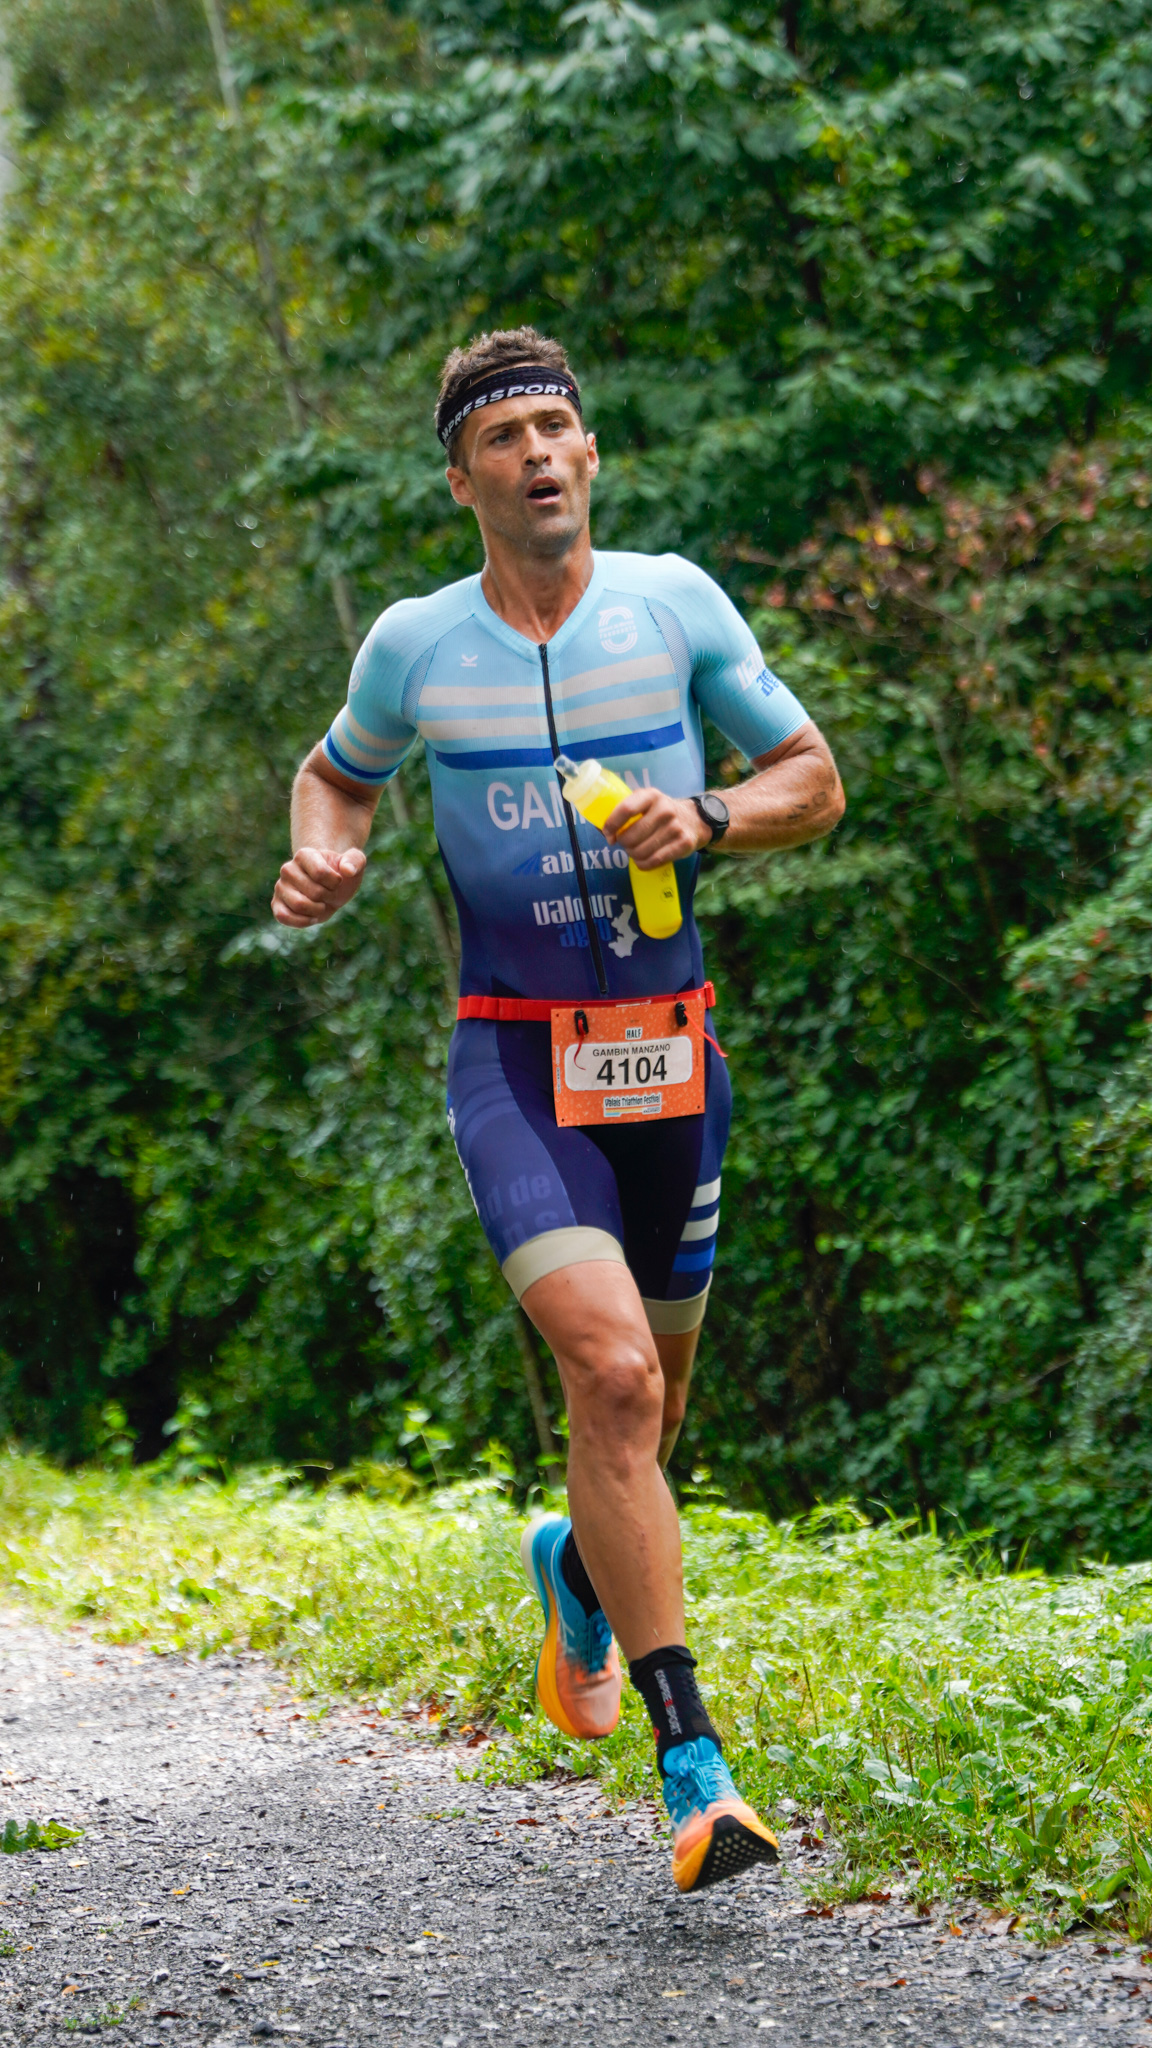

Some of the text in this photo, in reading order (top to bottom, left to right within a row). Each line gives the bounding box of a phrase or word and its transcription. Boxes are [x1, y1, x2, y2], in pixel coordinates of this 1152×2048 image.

[557, 918, 613, 948] ago
[626, 1029, 642, 1039] HALF
[592, 1043, 671, 1057] GAMBIN MANZANO
[596, 1054, 668, 1086] 4104
